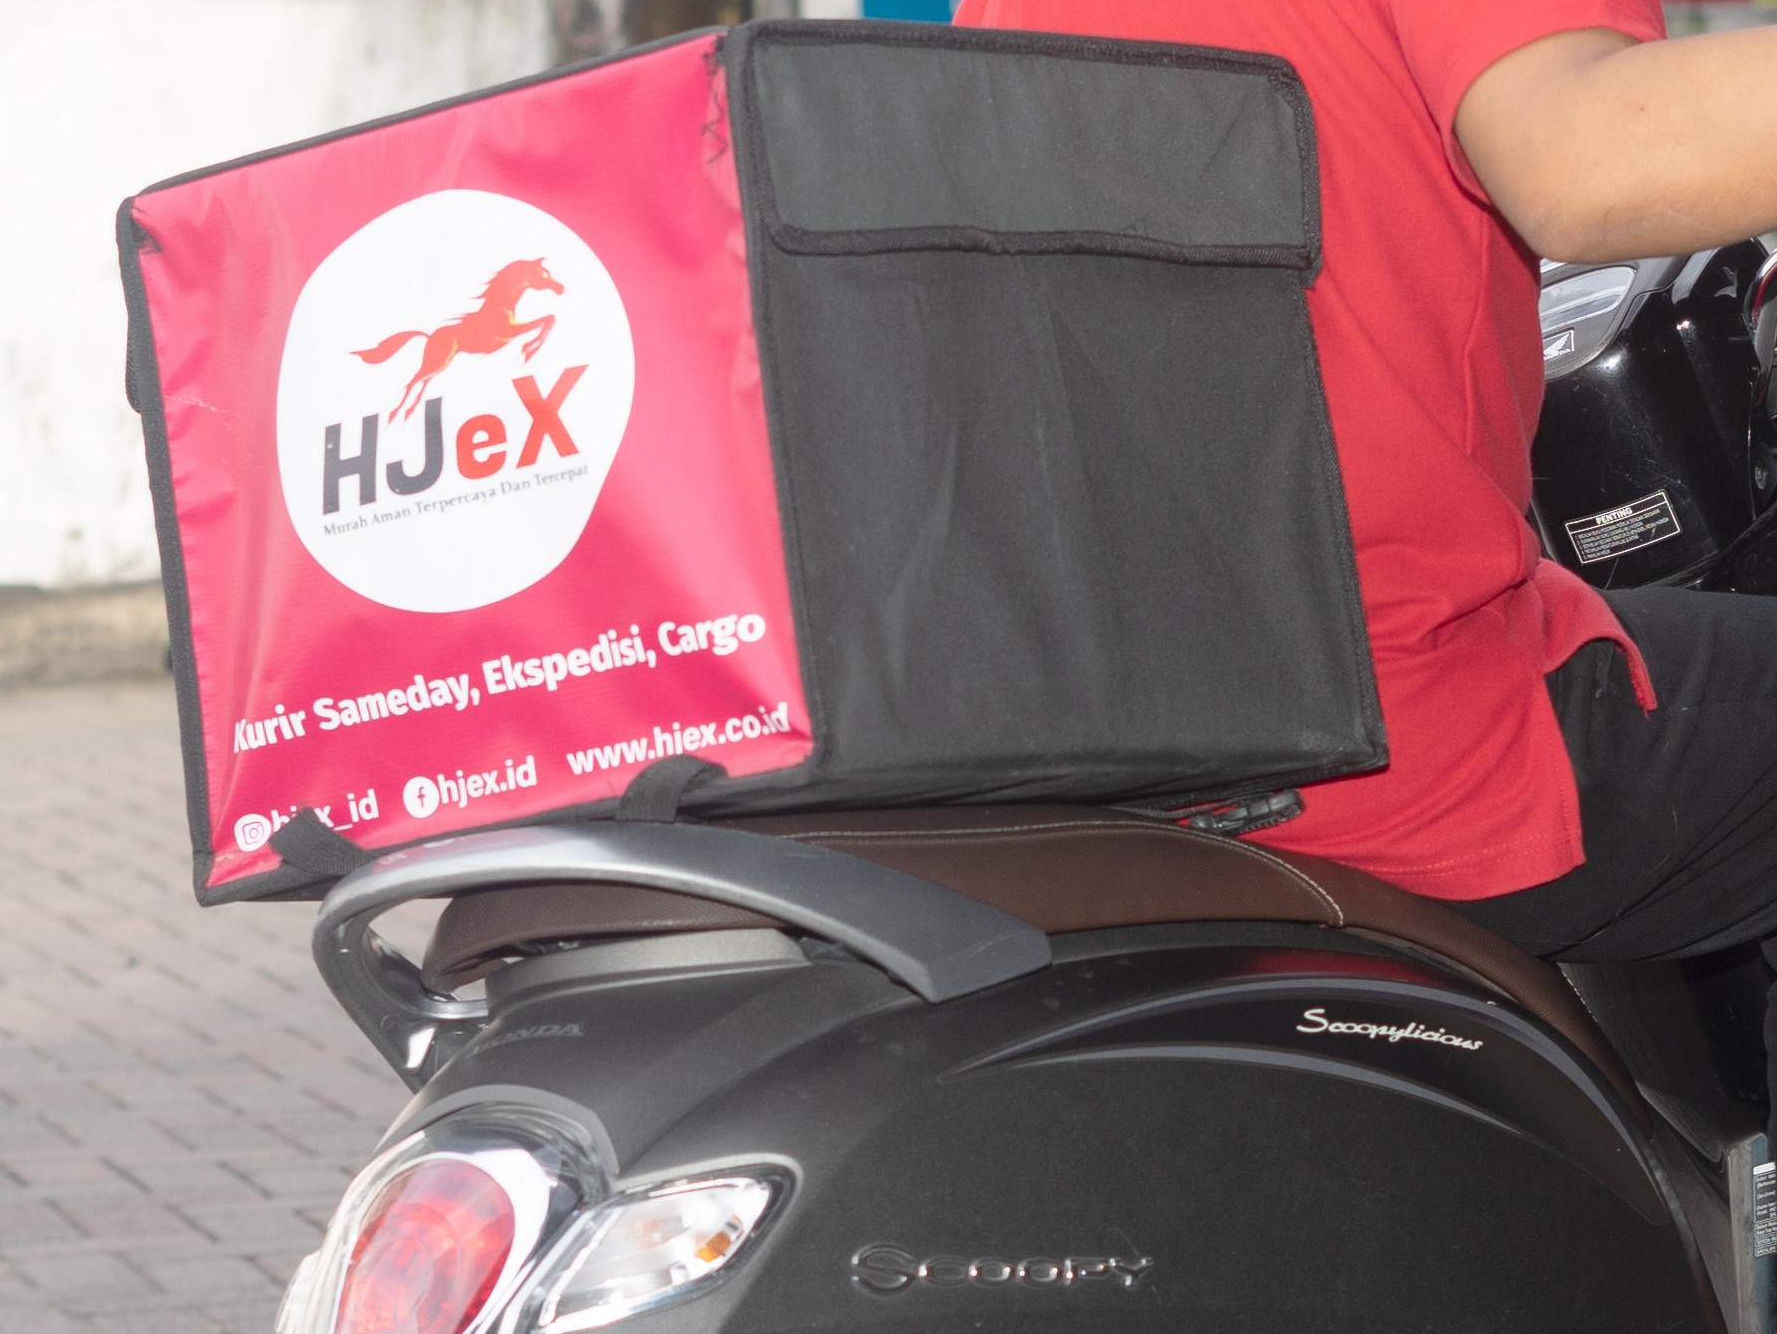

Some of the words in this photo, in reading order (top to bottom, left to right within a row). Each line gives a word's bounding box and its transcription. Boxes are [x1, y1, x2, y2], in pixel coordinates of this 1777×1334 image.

[322, 364, 590, 515] HJeX
[323, 515, 369, 537] Murah
[371, 507, 412, 525] Aman
[415, 488, 497, 515] Terpercaya
[500, 479, 532, 495] Dan
[533, 464, 590, 486] Tercepat
[1595, 507, 1633, 524] PENTING
[313, 673, 481, 731] Sameday,
[481, 624, 657, 695] Ekspedisi,
[657, 614, 767, 656] Cargo
[437, 755, 538, 809] hjex.id
[1295, 1008, 1484, 1050] Scoopylicious
